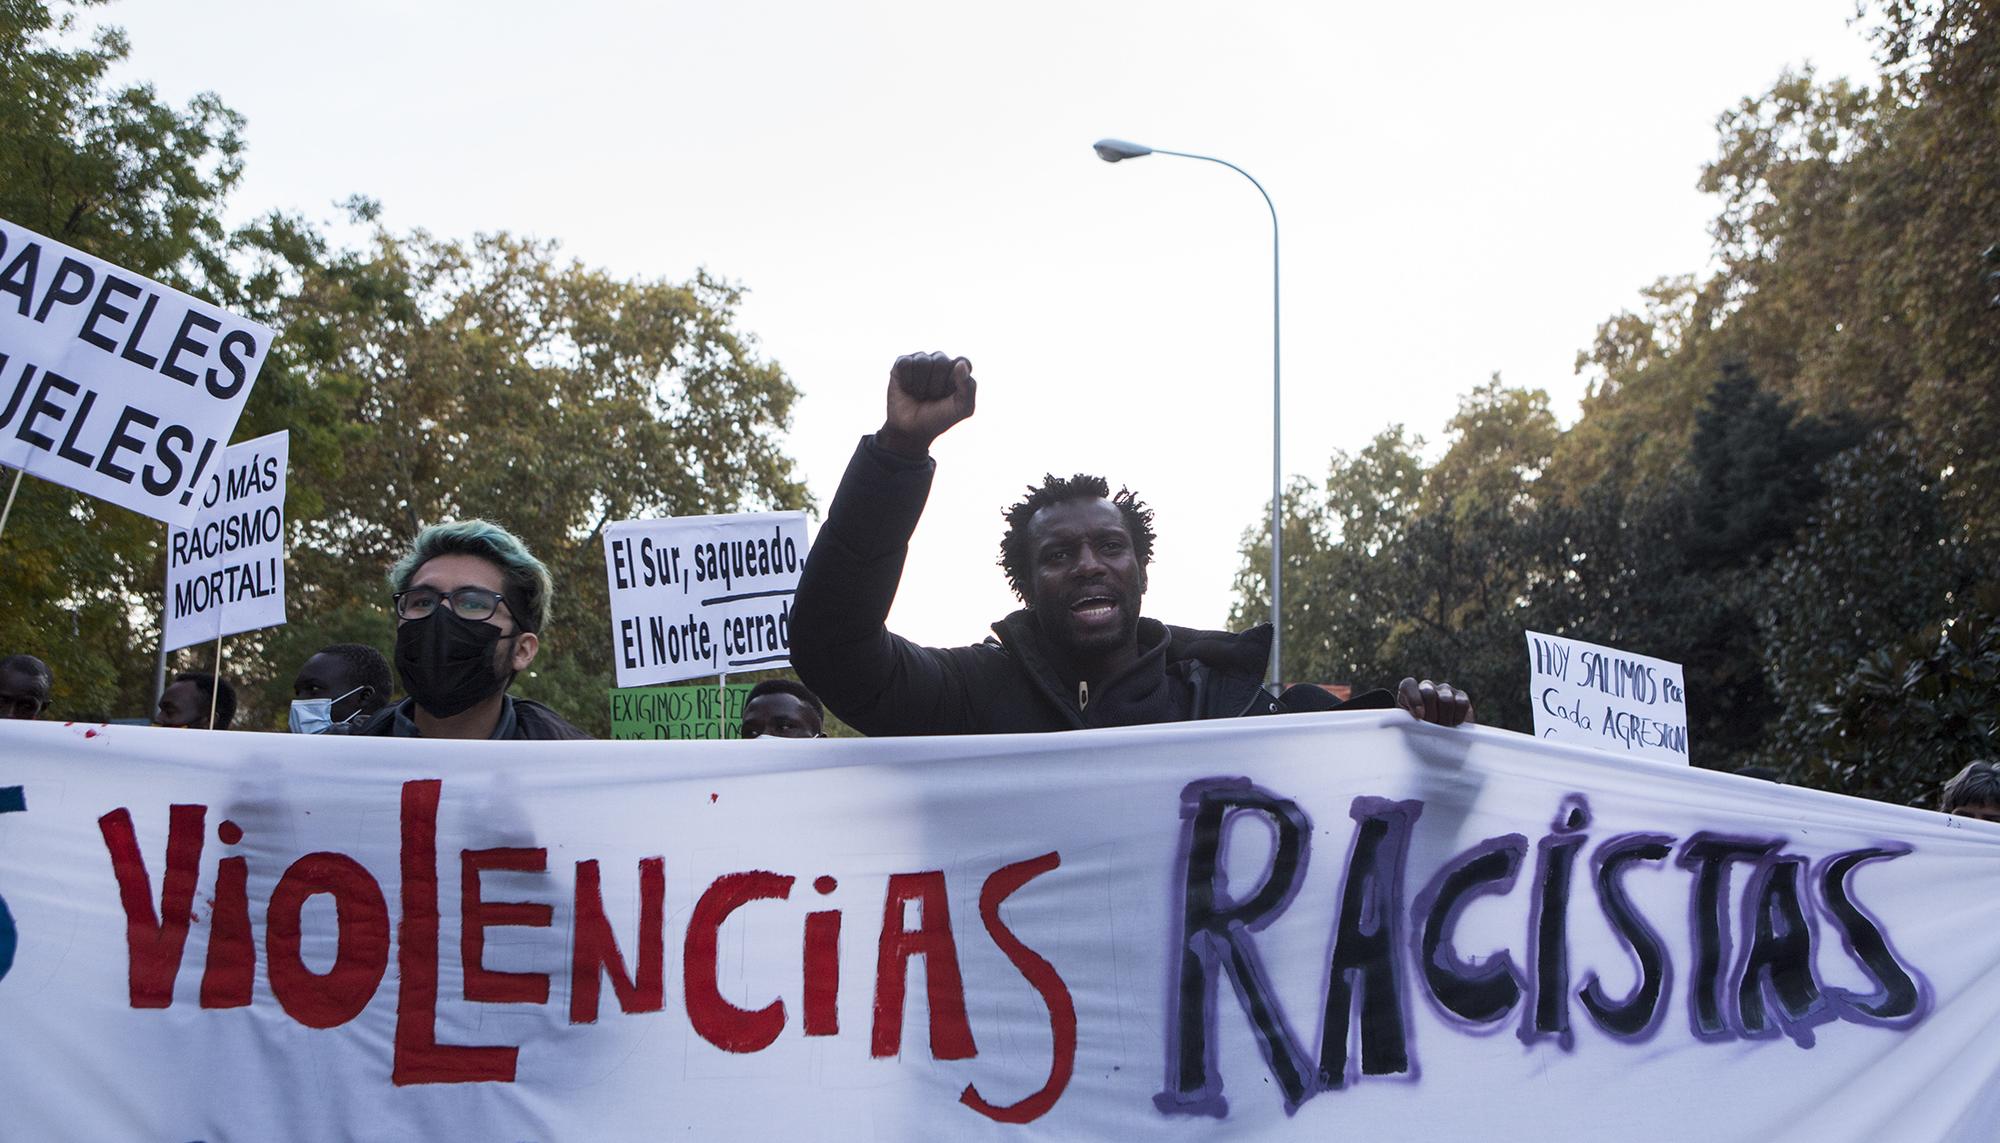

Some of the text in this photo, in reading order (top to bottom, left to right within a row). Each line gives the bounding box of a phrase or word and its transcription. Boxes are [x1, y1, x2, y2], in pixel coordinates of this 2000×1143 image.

[0, 229, 257, 400] APELES
[0, 353, 217, 506] UELES!
[199, 454, 278, 511] O MÁS
[172, 505, 281, 568] RACISMO
[612, 538, 636, 590] El
[641, 537, 689, 595] Sur,
[175, 558, 276, 618] MORTAL!
[621, 600, 790, 669] El Norte, cerrad
[1534, 637, 1571, 682] HOY
[1576, 651, 1658, 705] SALIMOS
[612, 687, 749, 724] EXIGIMOS RESPET
[1542, 687, 1687, 754] Cada AGRESION
